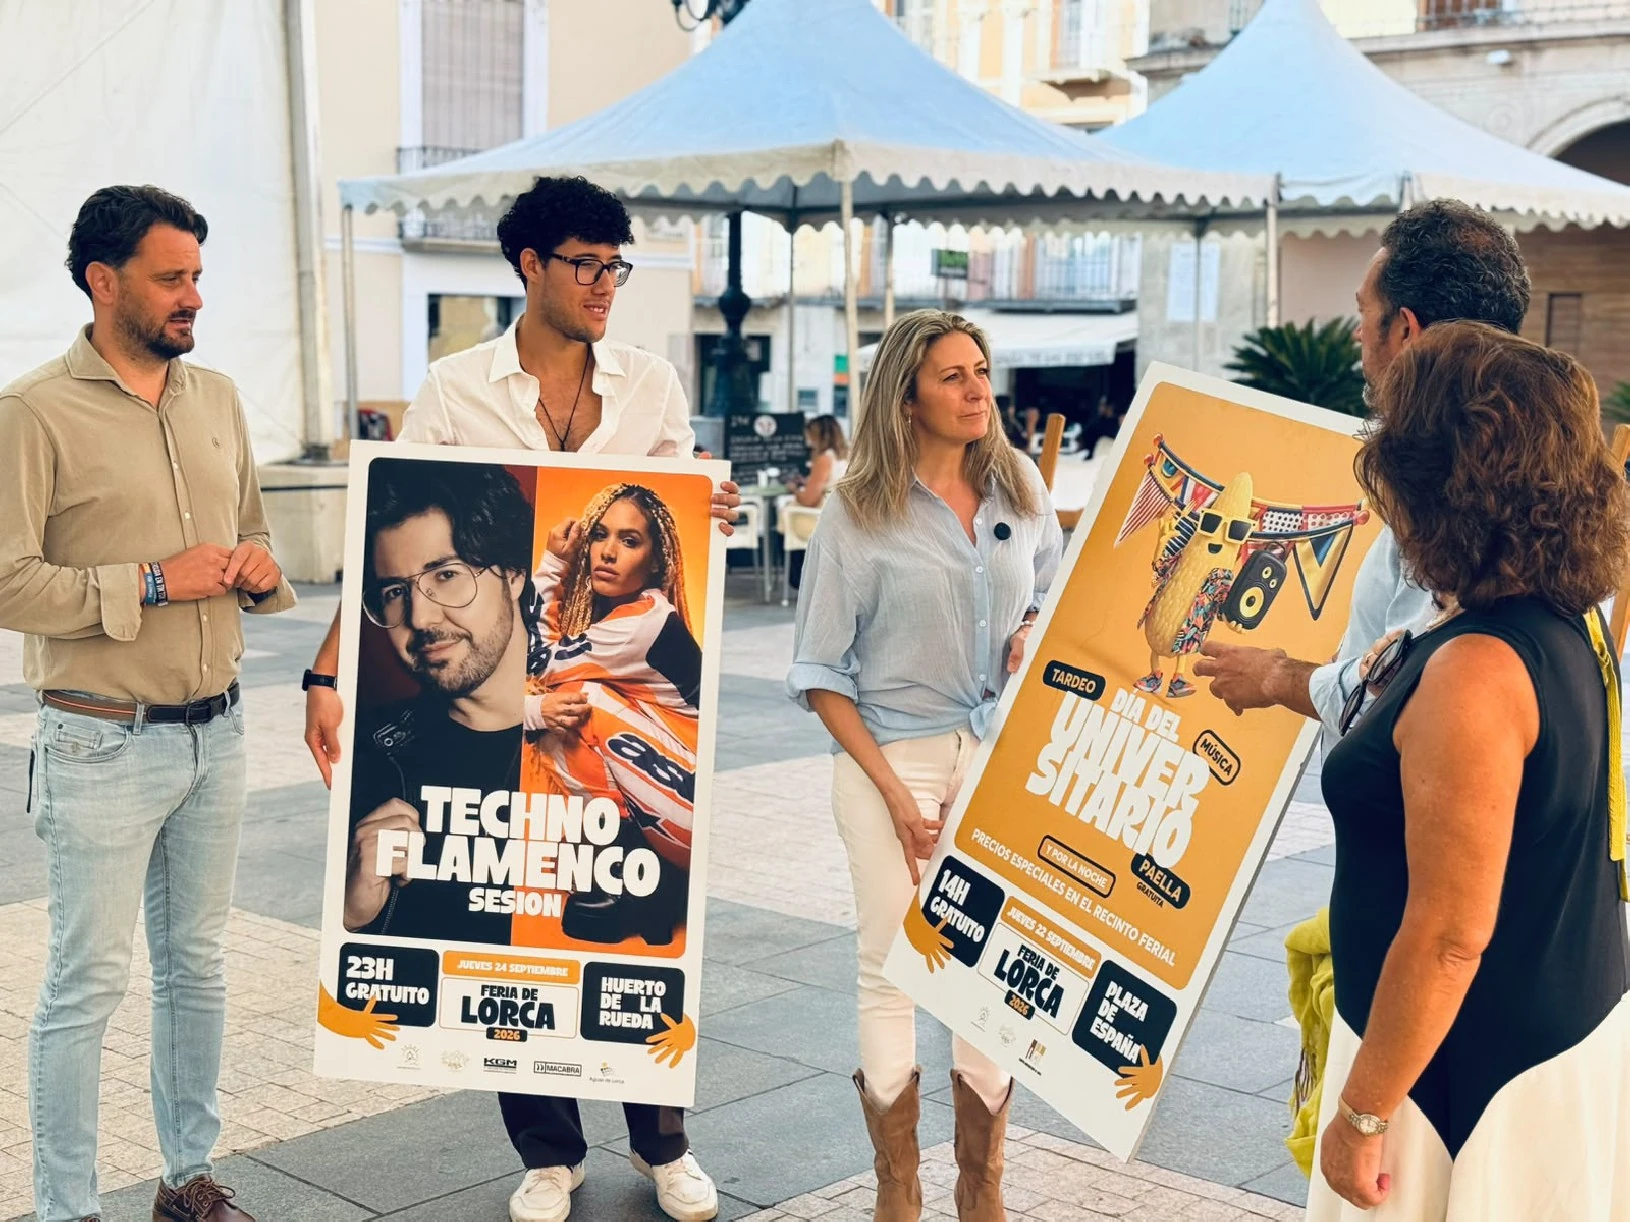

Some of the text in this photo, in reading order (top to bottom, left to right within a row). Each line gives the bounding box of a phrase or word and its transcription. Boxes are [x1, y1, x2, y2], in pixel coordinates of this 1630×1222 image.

[1052, 668, 1096, 694] TARDEO
[1110, 687, 1181, 743] DÍA DEL
[1050, 690, 1210, 809] UNIVER
[1200, 738, 1233, 776] MÚSICA
[421, 785, 621, 846] TECHNO
[1025, 742, 1194, 869] SITARIO
[375, 829, 661, 898] FLAMENCO
[1045, 844, 1108, 889] Y POR LA NOCHE
[1139, 859, 1182, 903] PAELLA
[468, 887, 562, 918] SESION
[938, 869, 971, 906] 14H
[971, 828, 1176, 968] PRECIOS ESPECIALES EN EL RECINTO FERIAL
[1136, 881, 1164, 908] GRATUITA
[930, 896, 985, 942] GRATUITO
[1007, 906, 1096, 971] JUEVES 22 SEPTIEMBRE
[346, 955, 394, 981] 23H
[457, 960, 569, 977] JUEVES 24 SEPTIEMBRE
[1017, 944, 1060, 981] FERIA DE
[345, 982, 430, 1005] GRATUITO
[481, 984, 538, 1001] FERIA DE
[601, 976, 666, 997] HUERTO
[994, 949, 1064, 1019] LORCA
[1105, 980, 1149, 1022] PLAZA
[461, 995, 555, 1030] LORCA
[599, 1010, 654, 1030] RUEDA
[600, 992, 662, 1013] DE LA
[1009, 994, 1029, 1016] 2026
[1097, 997, 1119, 1024] DE
[494, 1028, 521, 1041] 2026
[1089, 1016, 1141, 1065] ESPAÑA
[484, 1057, 517, 1067] KGM
[546, 1064, 580, 1074] MACABRA
